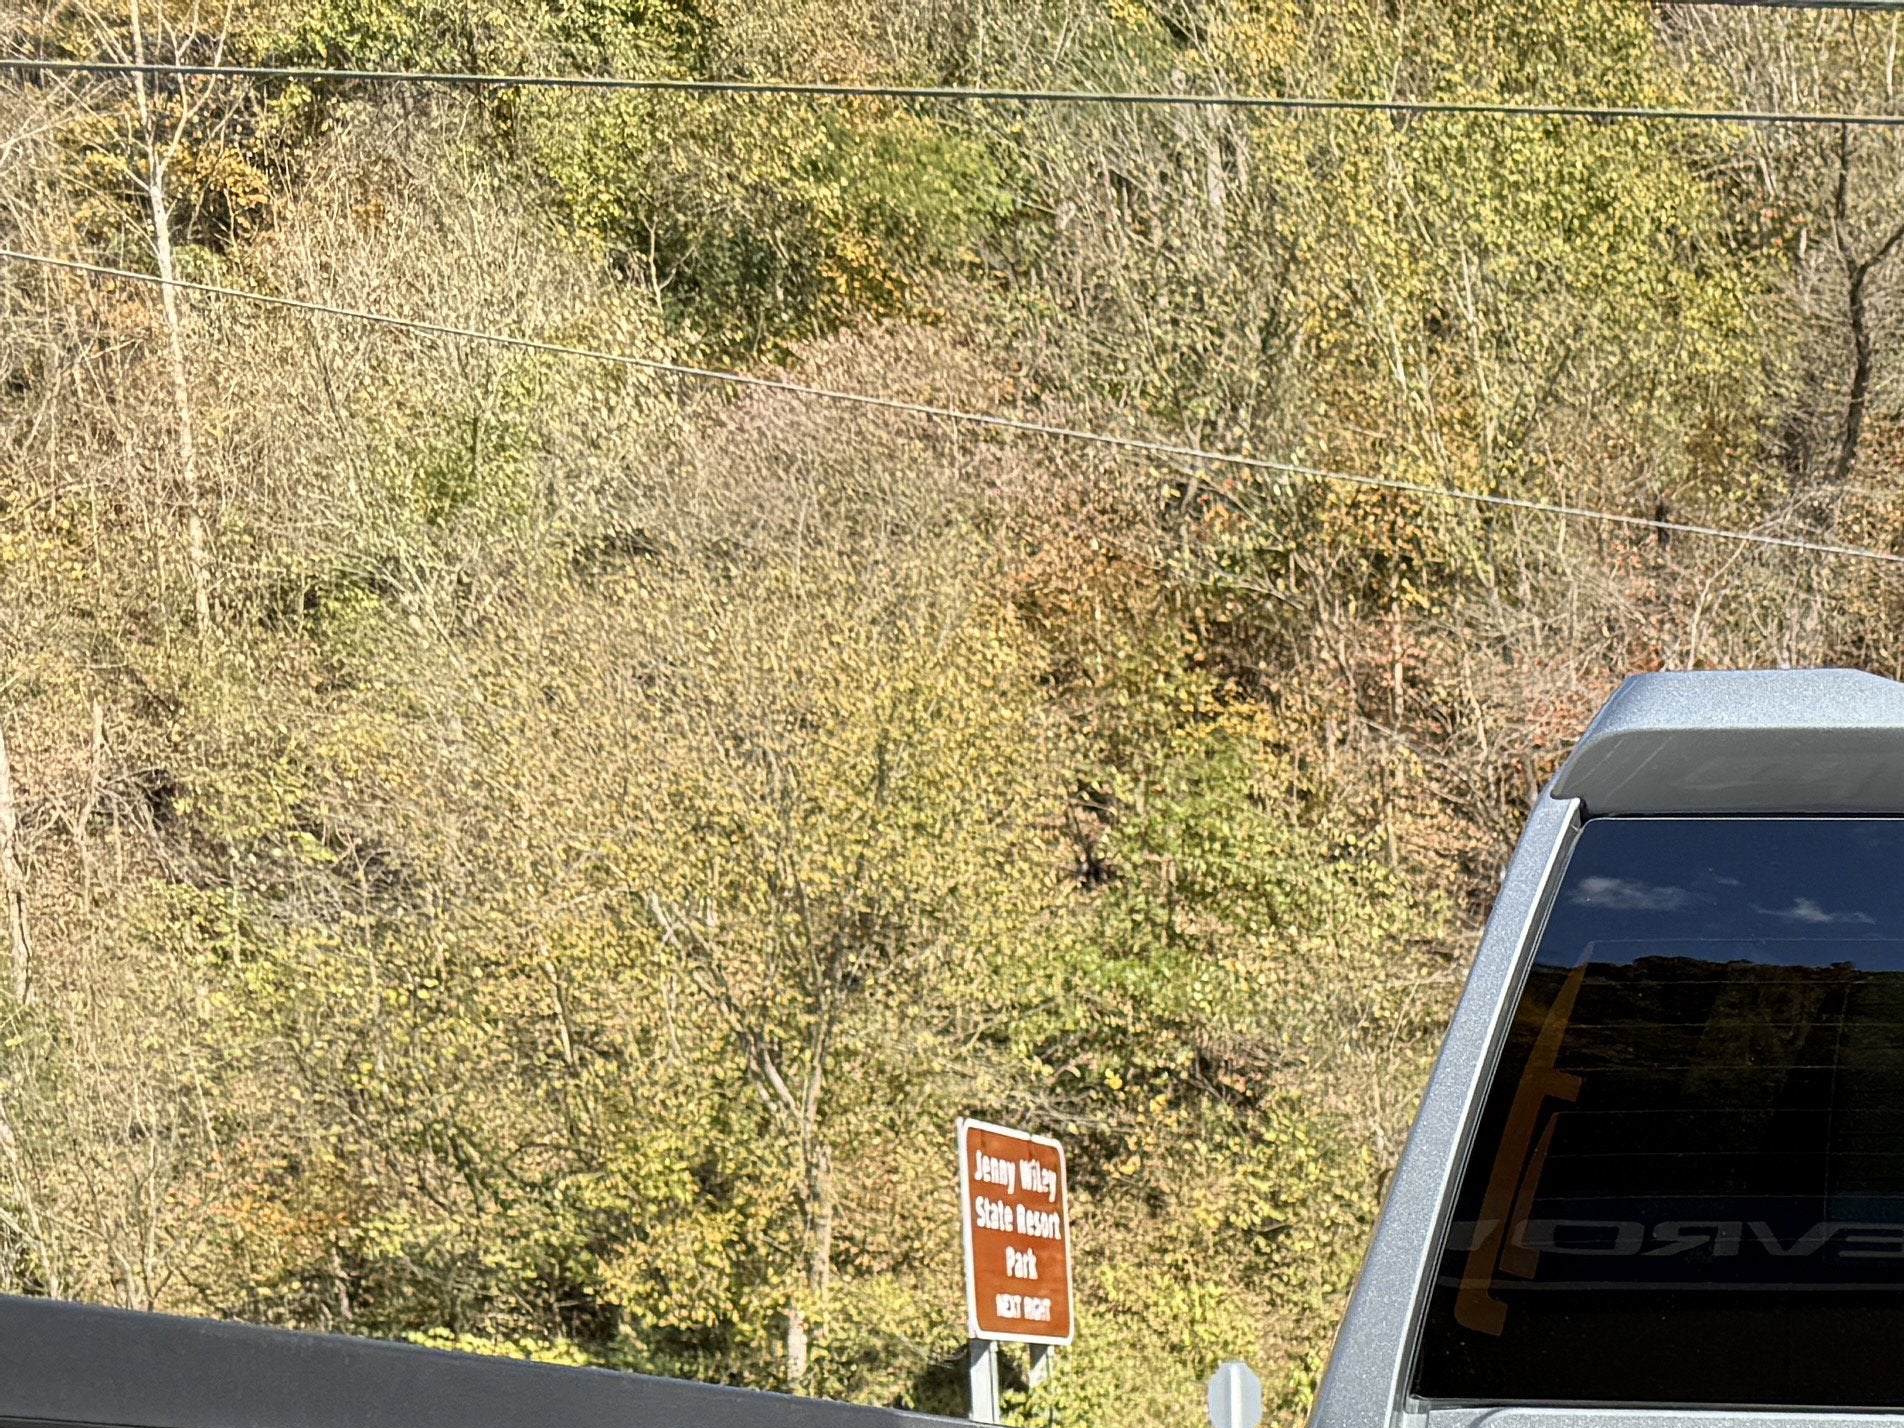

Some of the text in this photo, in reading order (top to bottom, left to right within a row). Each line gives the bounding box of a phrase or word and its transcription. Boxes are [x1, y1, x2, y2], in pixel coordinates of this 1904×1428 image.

[975, 1149, 1057, 1203] Jenny Wiley
[975, 1195, 1061, 1240] State Resort
[1005, 1245, 1038, 1280] Park
[995, 1293, 1022, 1319] NEXT
